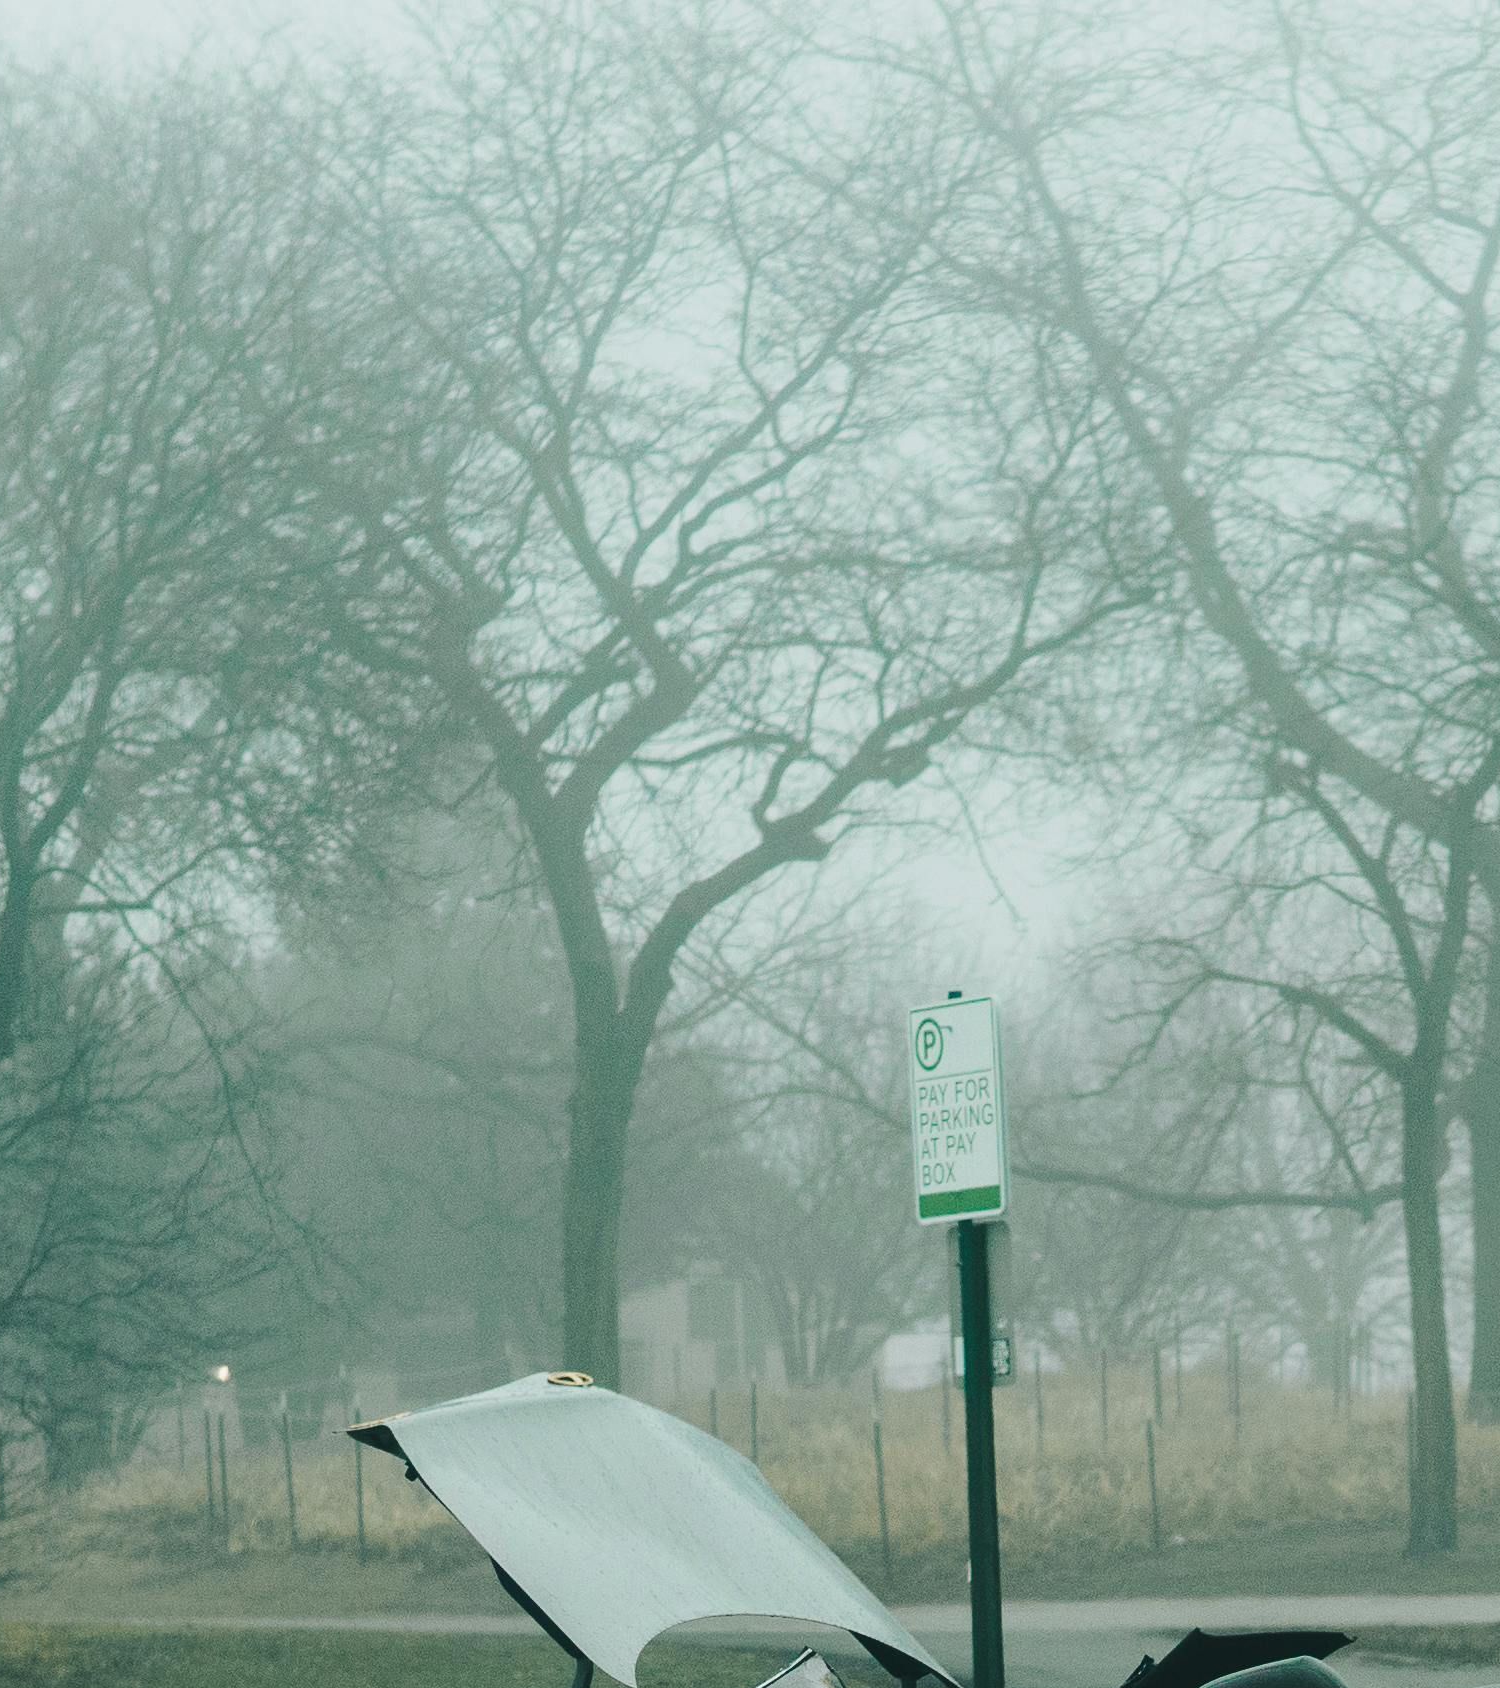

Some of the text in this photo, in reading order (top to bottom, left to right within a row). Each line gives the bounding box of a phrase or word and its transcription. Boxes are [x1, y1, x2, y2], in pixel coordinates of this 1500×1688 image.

[922, 1030, 937, 1060] P
[919, 1077, 991, 1109] PAY FOR
[919, 1103, 994, 1135] PARKING
[921, 1131, 977, 1160] AT PAY
[922, 1163, 956, 1187] BOX
